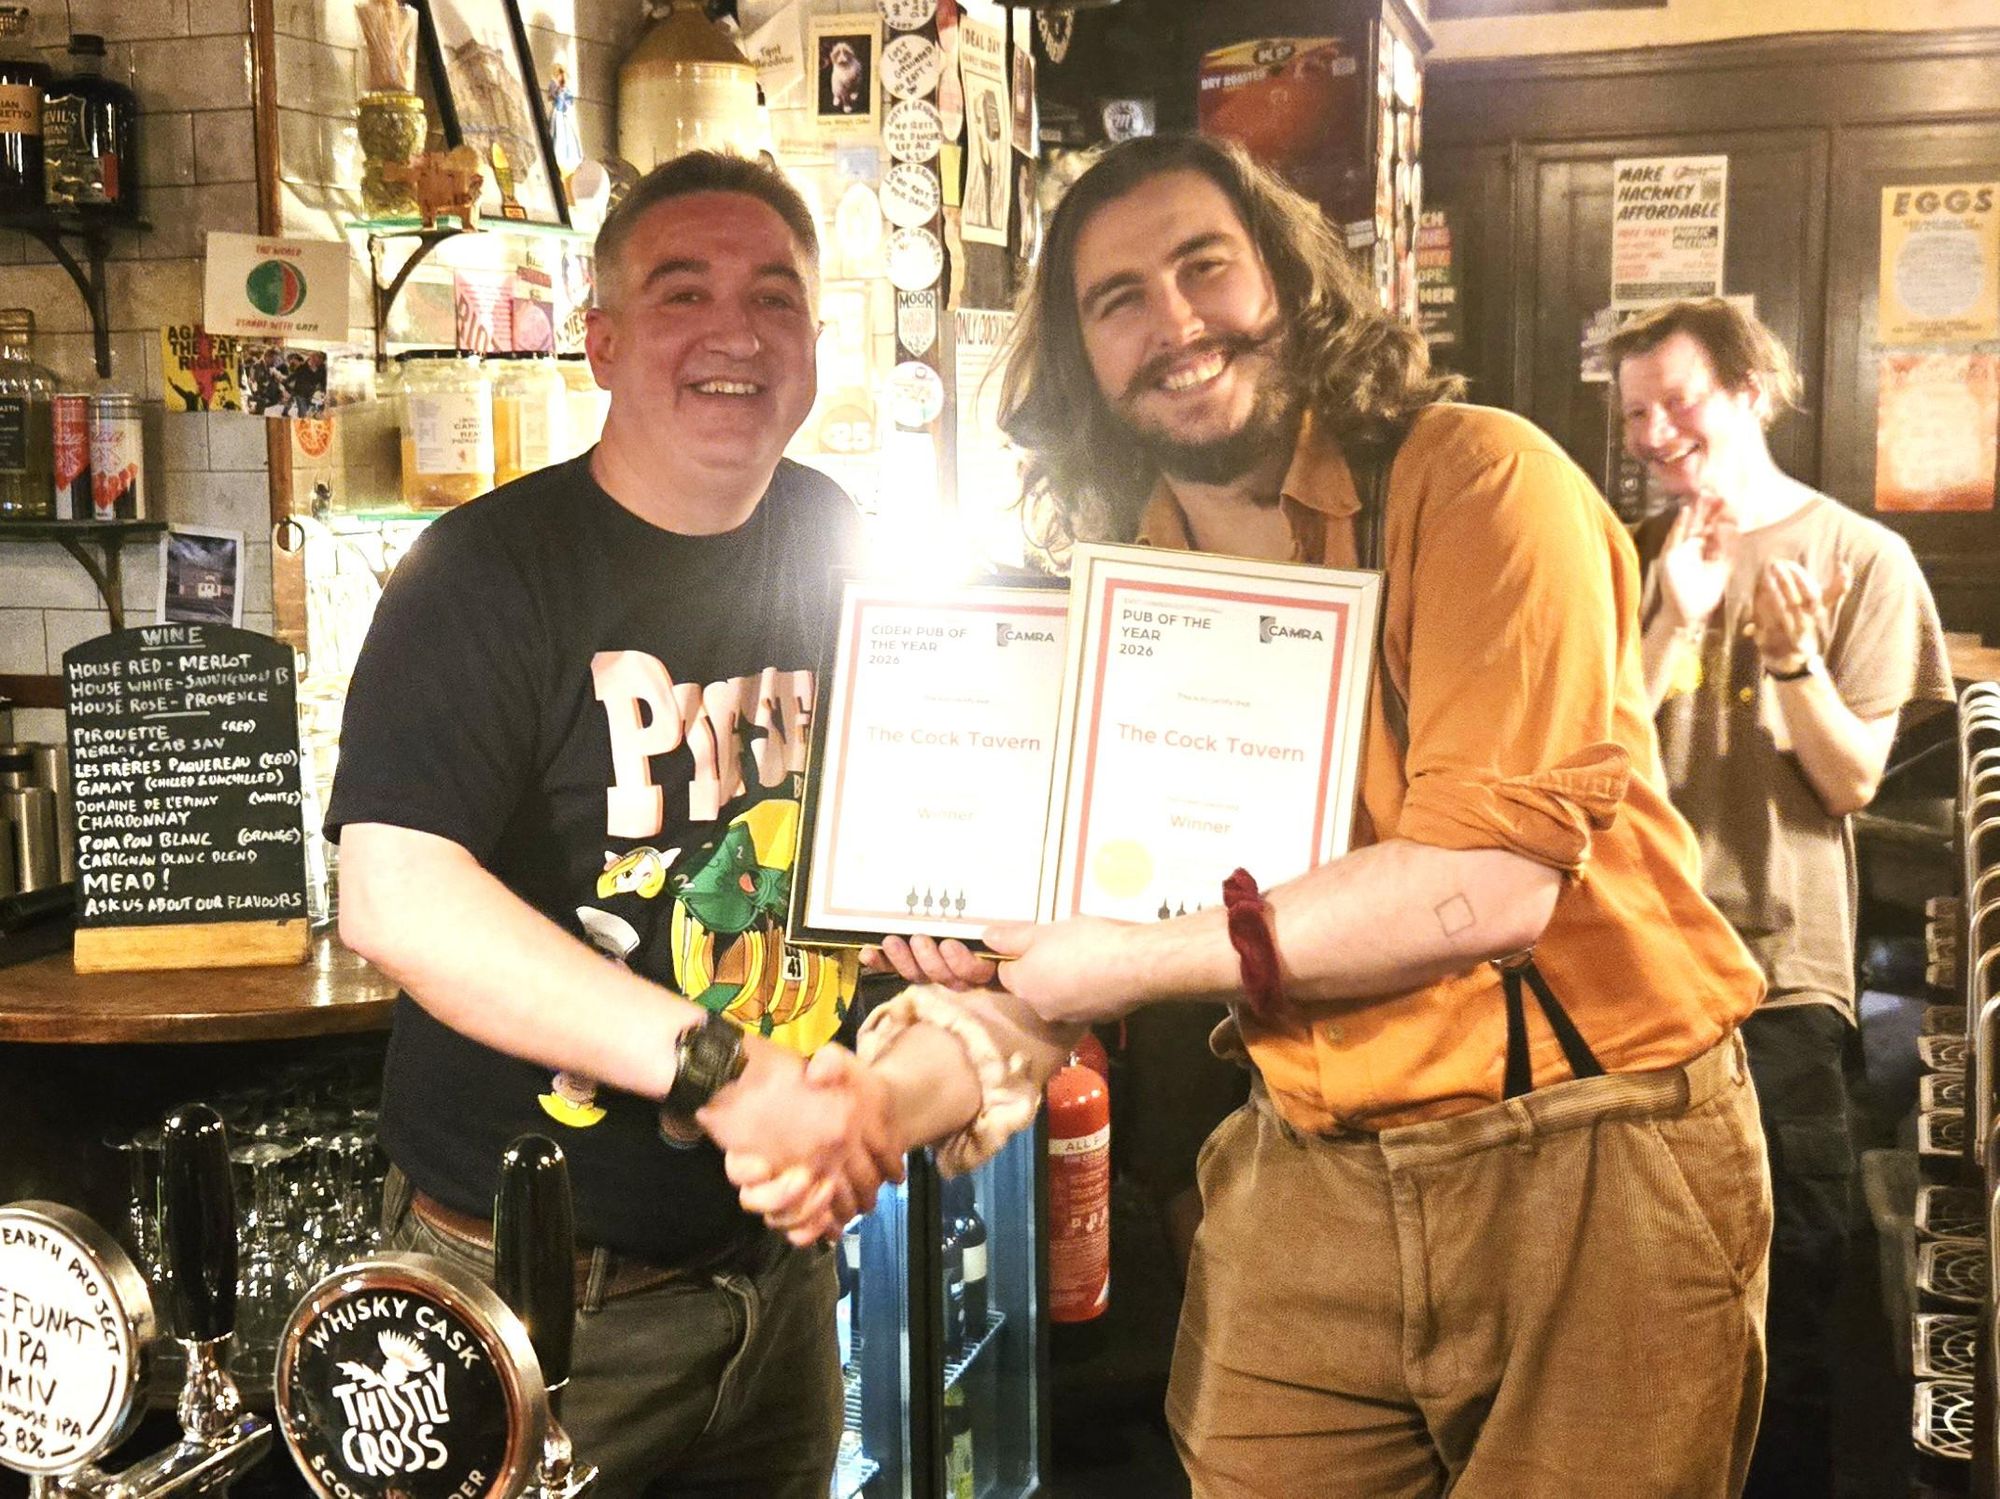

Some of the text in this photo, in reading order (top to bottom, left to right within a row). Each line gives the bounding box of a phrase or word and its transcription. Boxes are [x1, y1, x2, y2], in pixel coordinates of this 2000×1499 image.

[1618, 165, 1665, 183] MAKE
[1617, 184, 1695, 202] HACKNEY
[1893, 189, 1994, 217] EGGS
[1616, 202, 1720, 221] AFFORDABLE
[899, 292, 934, 309] MOOR
[1123, 609, 1212, 630] PUB OF THE
[141, 627, 203, 646] WINE
[871, 625, 967, 639] CIDER PUB OF
[1004, 631, 1055, 643] CAMRA
[1122, 627, 1161, 641] YEAR
[1269, 624, 1323, 642] CAMRA
[871, 640, 938, 652] THE YEAR
[1119, 644, 1154, 657] 2026
[69, 661, 122, 680] HOUSE
[129, 658, 162, 675] RED
[179, 654, 252, 672] MERLOT
[71, 681, 122, 699] HOUSE
[71, 699, 124, 716] HOUSE
[185, 690, 268, 710] PROVENCE
[73, 725, 171, 746] PIROUETTE
[150, 739, 186, 753] CAB
[191, 737, 226, 751] SAV
[867, 726, 1041, 751] The Cock Tavern
[1117, 723, 1305, 762] The Cock Tavern
[75, 763, 100, 779] LES
[169, 756, 251, 773] PAQUEREAU
[76, 780, 135, 797] GAMAY
[75, 800, 137, 814] DOMAINE
[144, 798, 161, 811] DE
[78, 811, 191, 831] CHARDONNAY
[1169, 814, 1231, 834] Winner
[79, 836, 120, 853] POM
[123, 833, 153, 849] PON
[159, 831, 213, 848] BLANC
[78, 850, 258, 870] CARIGNAN BLANC BLEND
[84, 892, 302, 917] ASK US ABOUT OUR FLAVOURS
[1065, 1140, 1087, 1152] ALL
[2, 1227, 121, 1355] EARTH PROJECT
[307, 1296, 481, 1370] WHISKY CASK
[3, 1329, 48, 1369] IPA
[331, 1362, 450, 1432] THISTLY
[56, 1417, 82, 1439] IPA
[341, 1424, 448, 1477] CROSS
